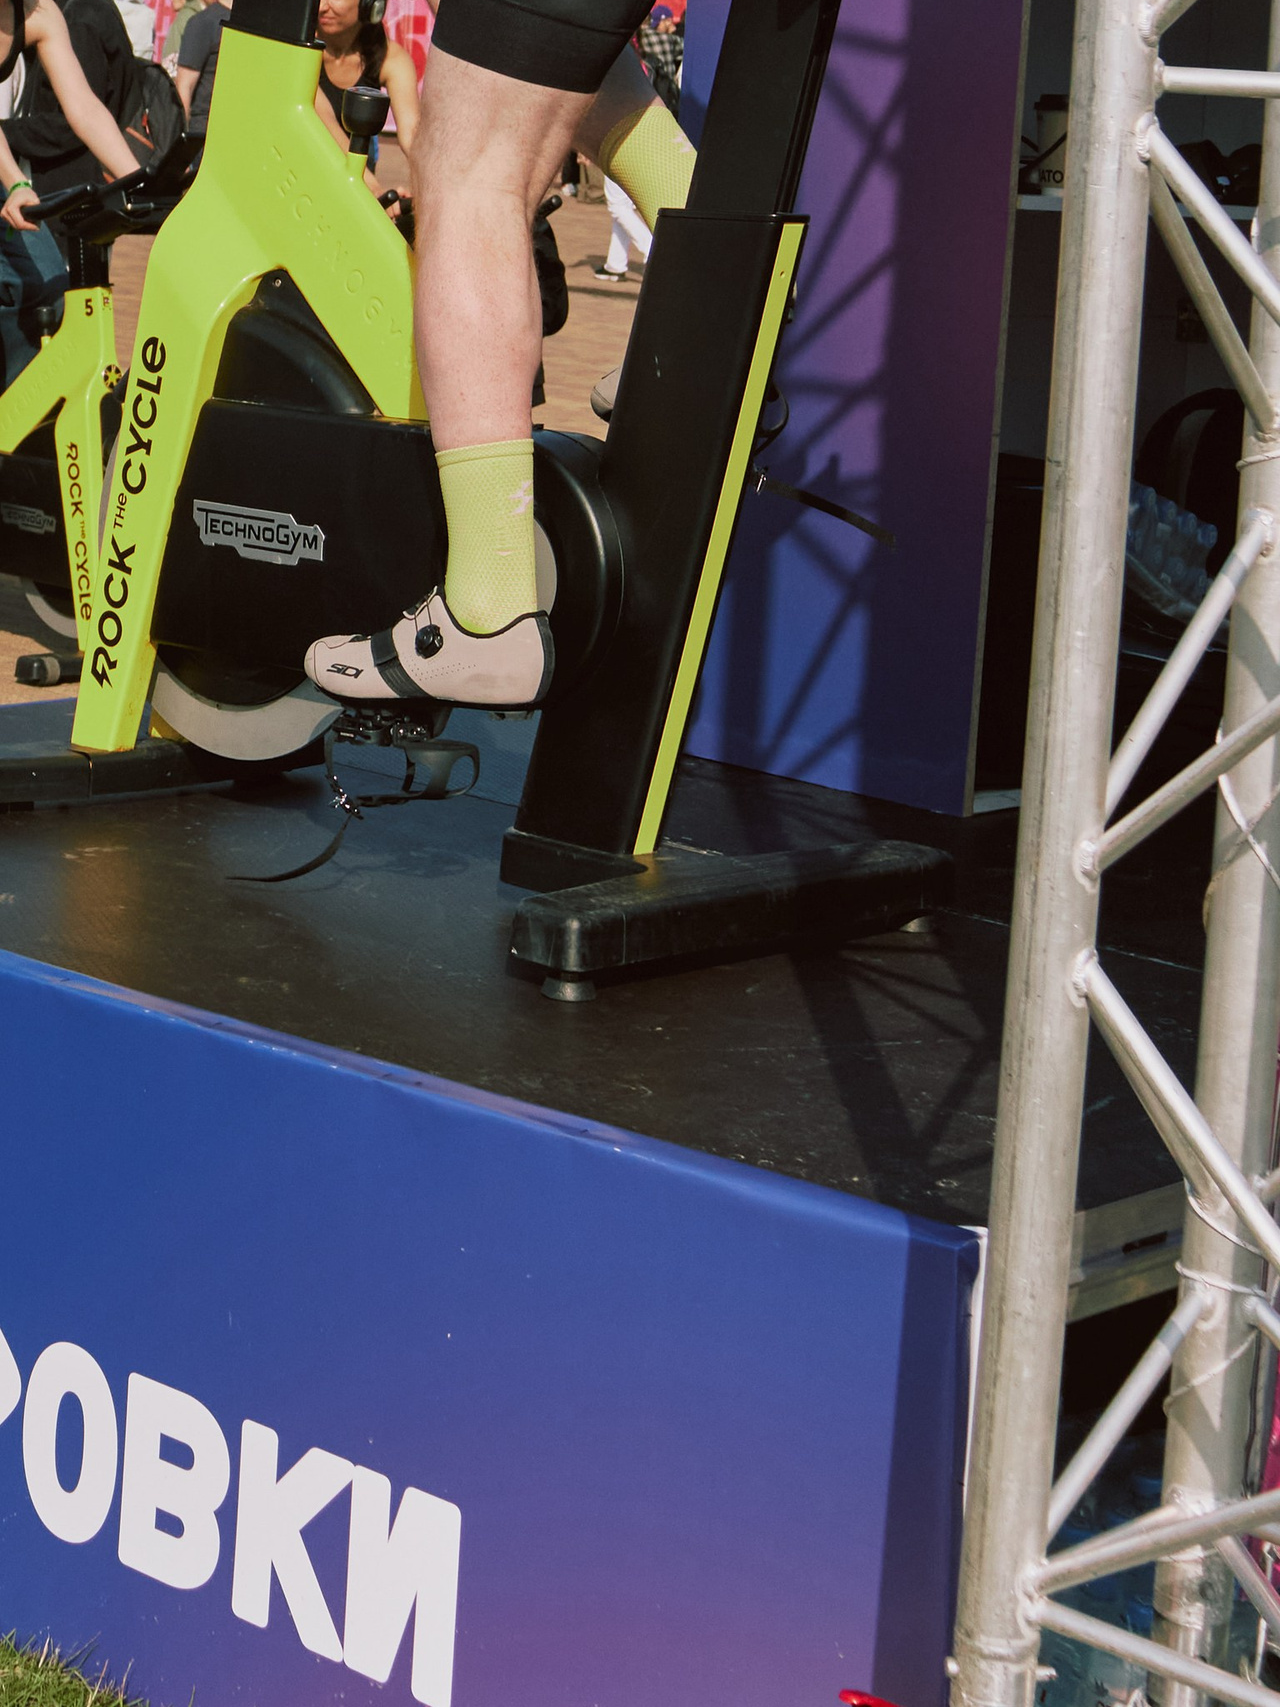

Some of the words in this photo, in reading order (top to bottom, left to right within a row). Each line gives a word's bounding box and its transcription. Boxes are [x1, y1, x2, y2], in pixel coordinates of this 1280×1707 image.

[85, 297, 94, 317] 5
[66, 441, 83, 518] ROCK
[90, 533, 136, 689] ROCK
